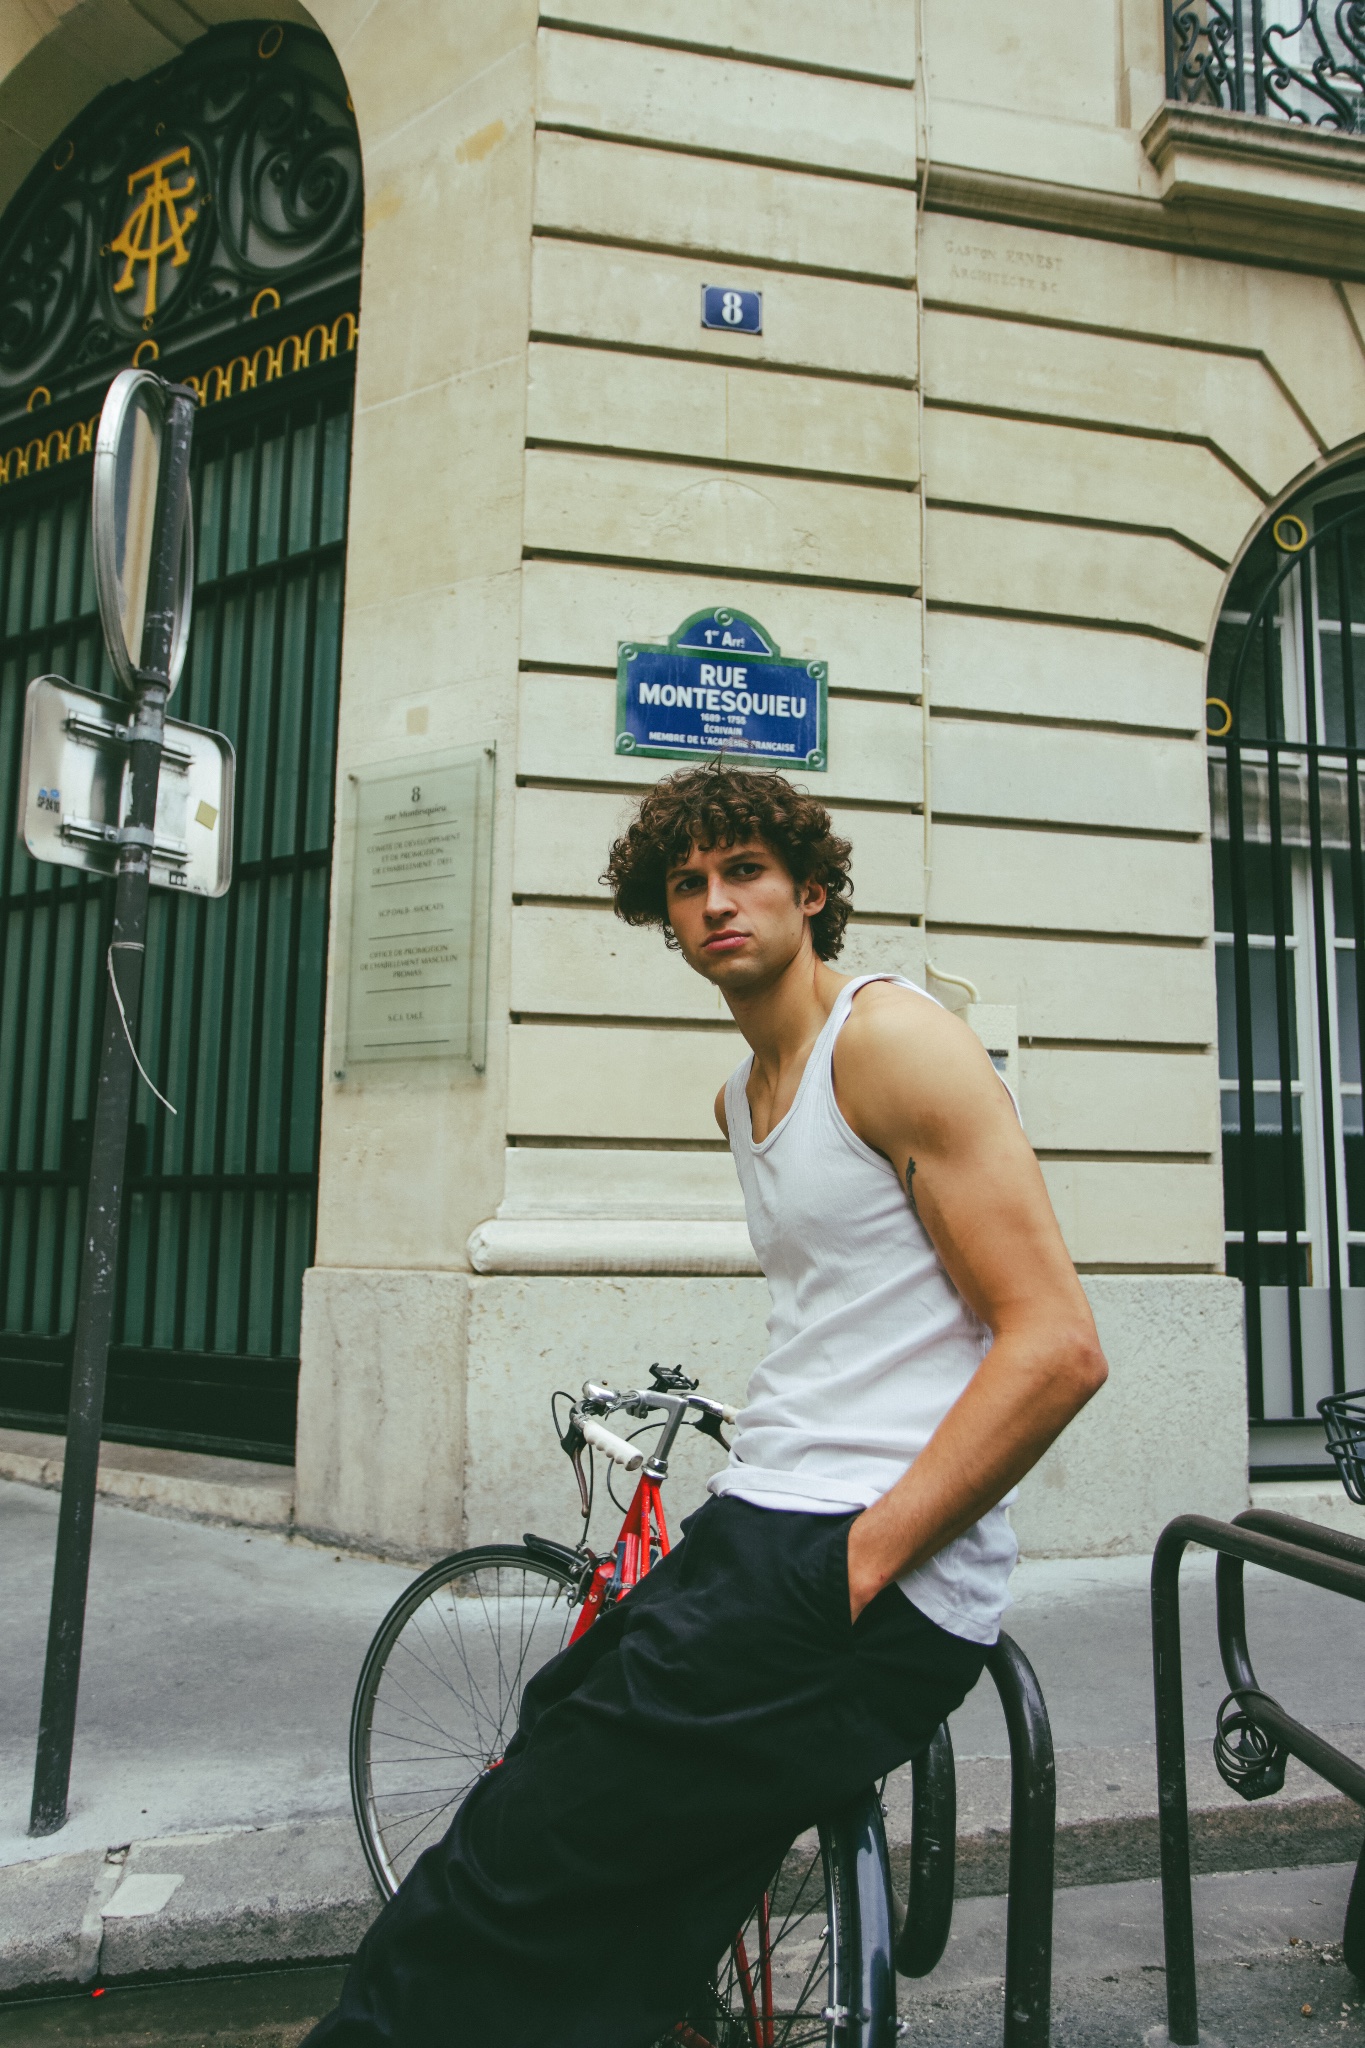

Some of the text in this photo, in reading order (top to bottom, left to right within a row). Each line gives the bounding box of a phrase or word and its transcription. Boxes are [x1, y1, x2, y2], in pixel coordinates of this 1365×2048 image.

[721, 291, 743, 325] 8
[700, 664, 748, 690] RUE
[638, 682, 807, 719] MONTESQUIEU
[648, 731, 686, 743] MEMBRE
[687, 735, 699, 745] DE
[703, 724, 743, 736] ÉCRIVAIN
[411, 785, 421, 802] 8
